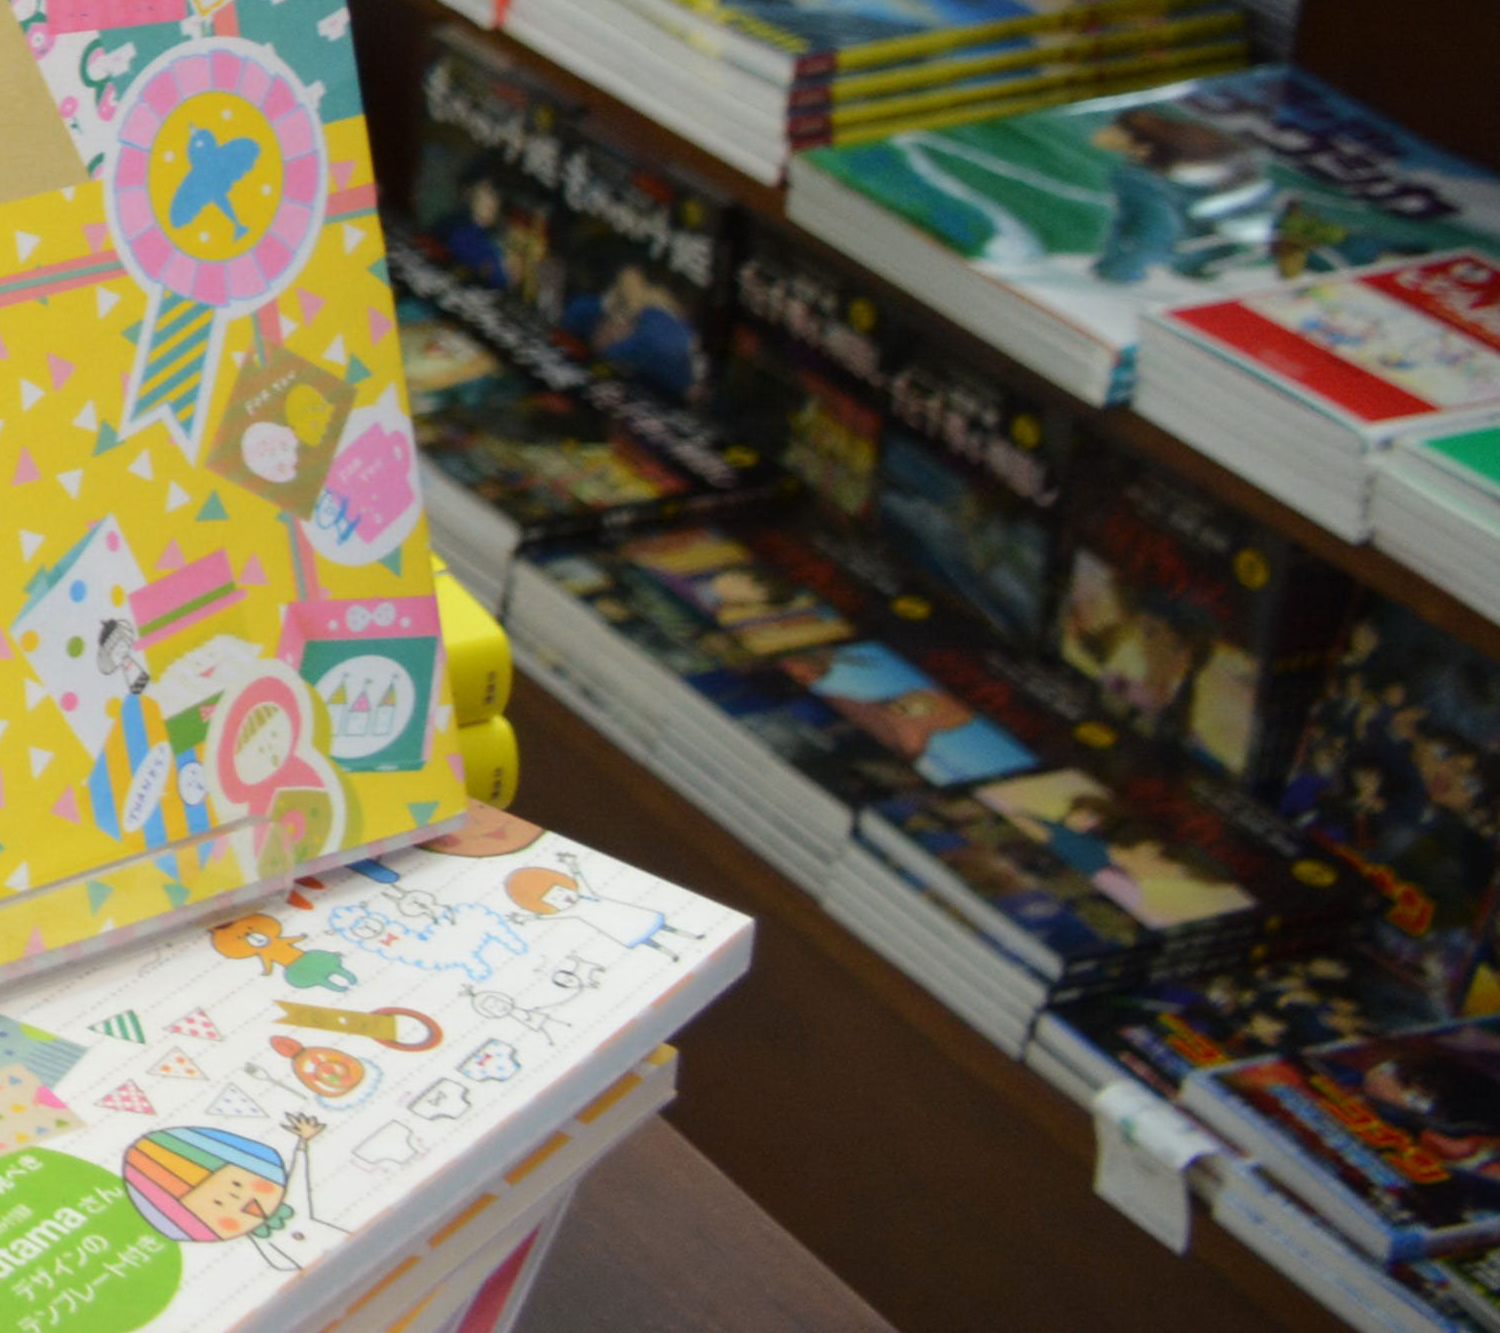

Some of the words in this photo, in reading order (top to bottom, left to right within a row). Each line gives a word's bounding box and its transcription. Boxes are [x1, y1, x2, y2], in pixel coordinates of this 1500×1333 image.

[11, 1233, 111, 1301] デザインの
